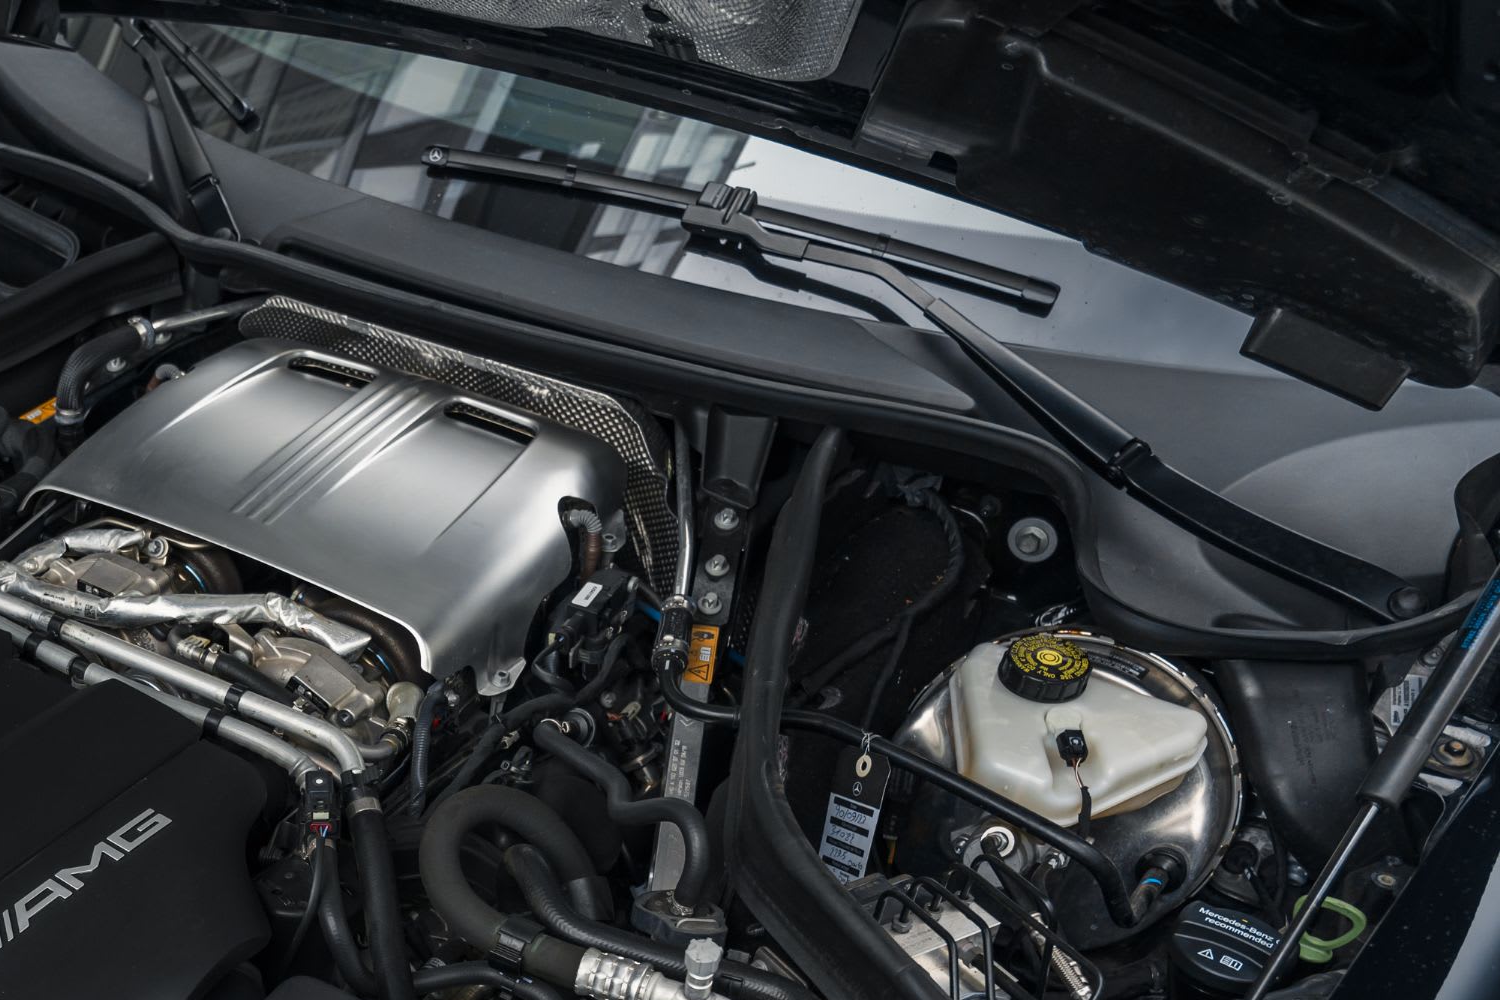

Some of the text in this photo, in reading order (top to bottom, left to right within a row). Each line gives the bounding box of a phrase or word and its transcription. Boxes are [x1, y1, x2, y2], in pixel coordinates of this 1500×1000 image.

[14, 808, 172, 933] AMG
[1199, 907, 1274, 941] Mercedes-Benz
[1205, 917, 1274, 949] recommended
